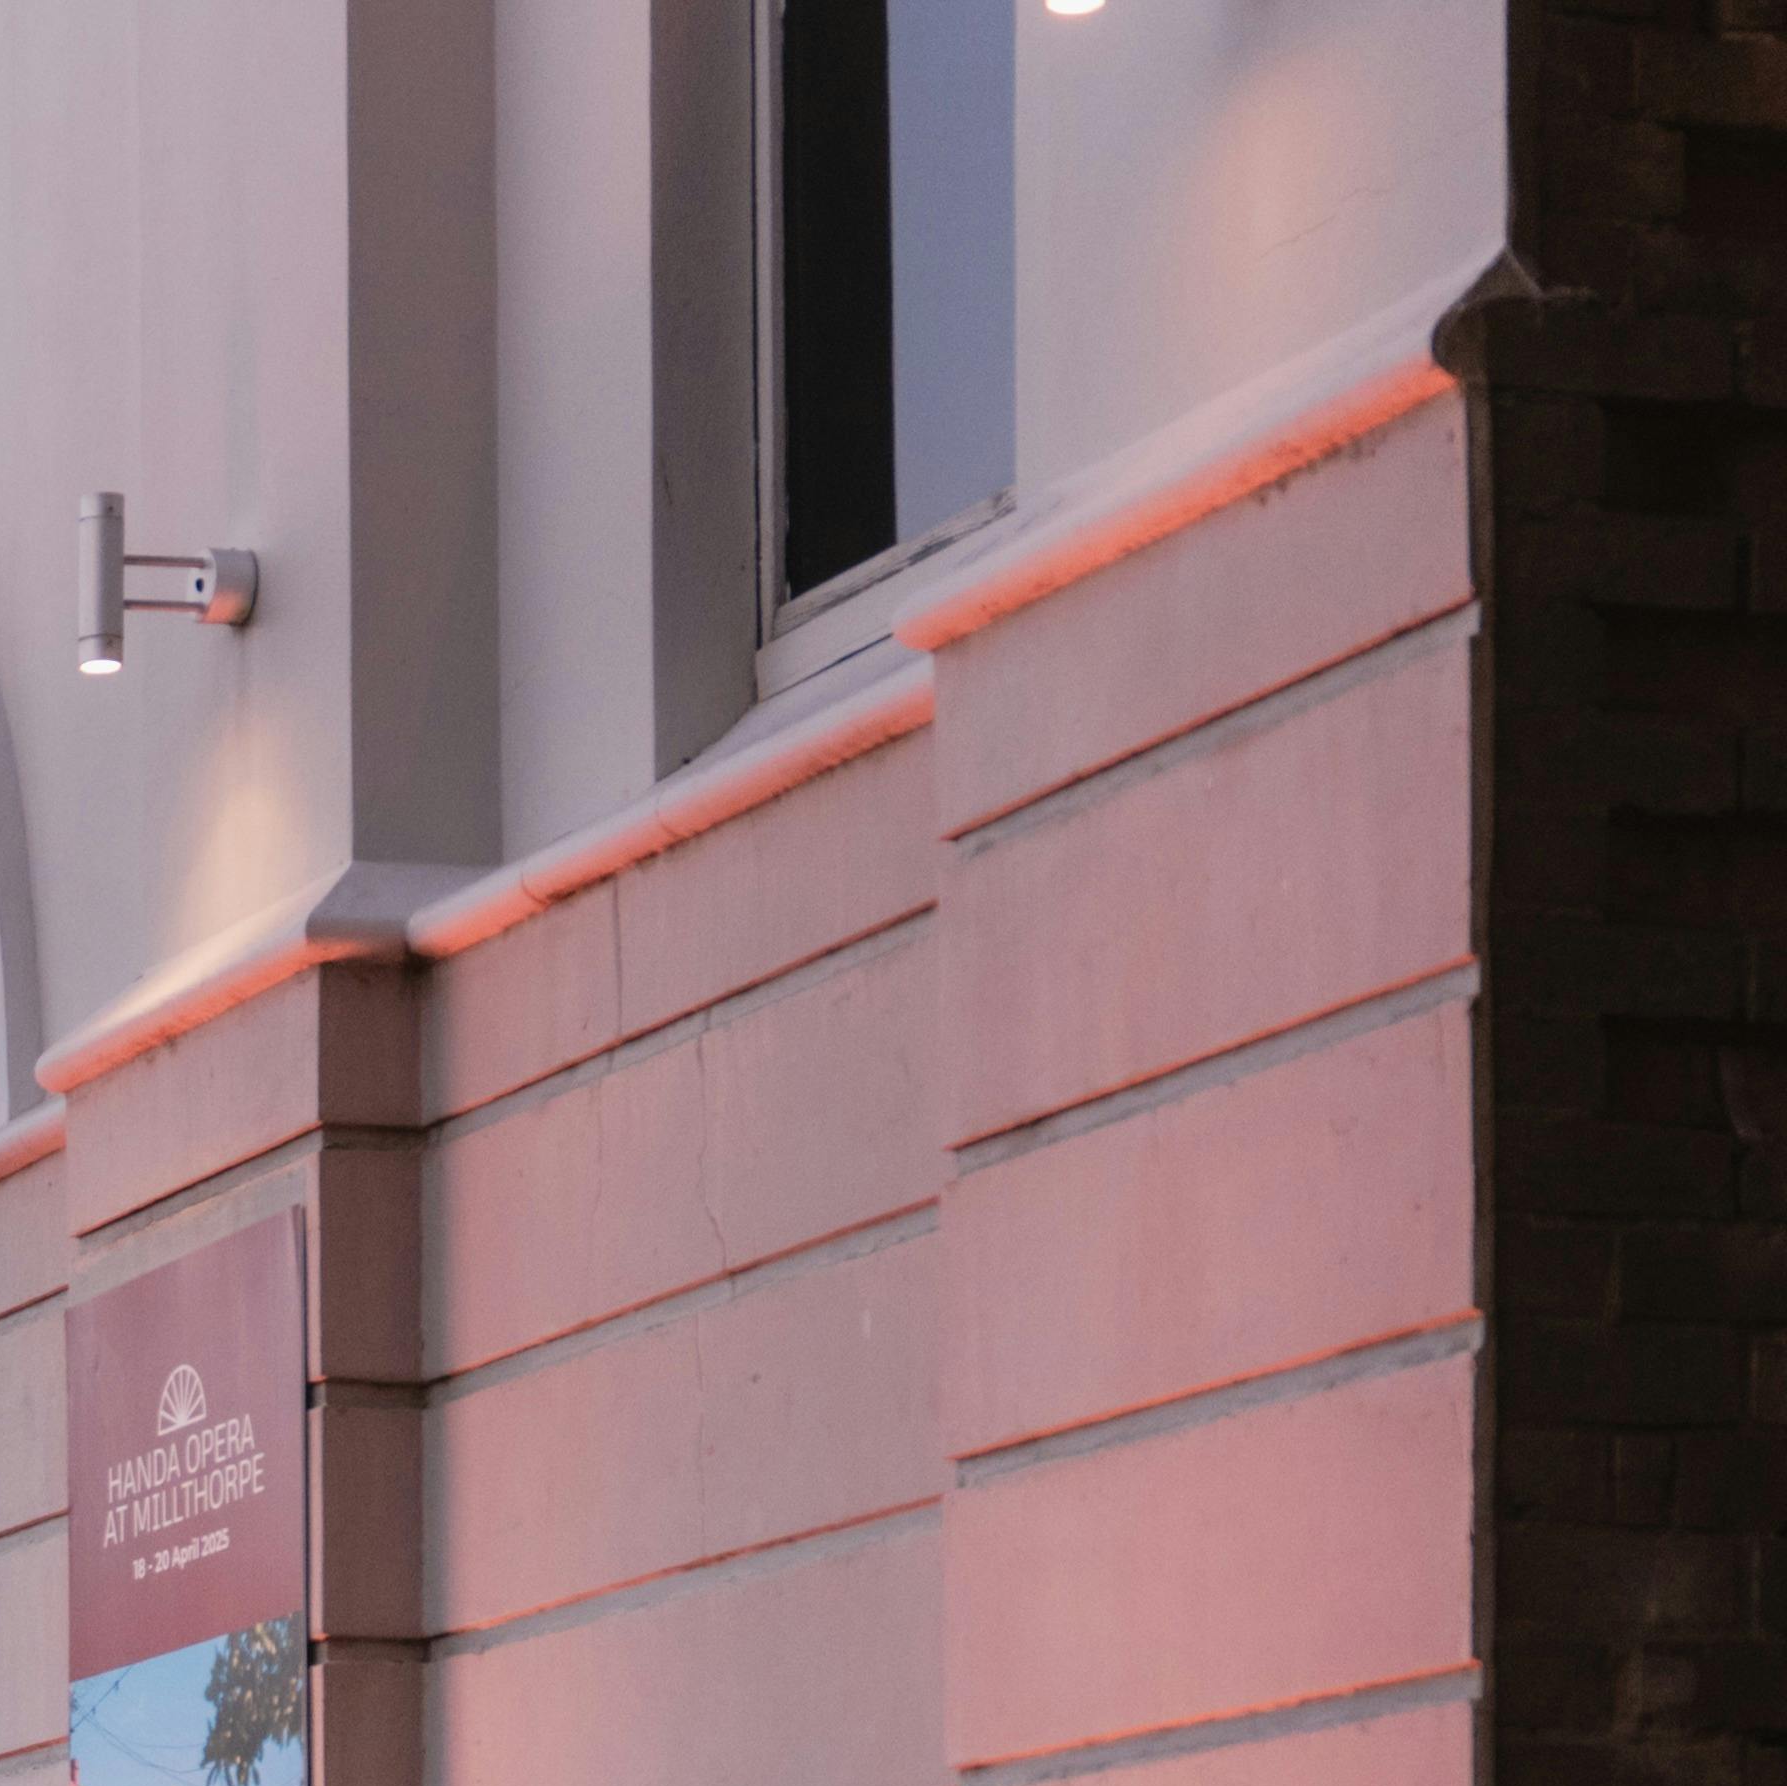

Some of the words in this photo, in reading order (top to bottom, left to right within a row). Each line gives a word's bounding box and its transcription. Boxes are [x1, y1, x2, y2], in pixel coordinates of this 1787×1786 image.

[103, 1504, 129, 1549] AT
[133, 1452, 266, 1538] MILLTHORPE
[108, 1442, 182, 1504] HANDA
[185, 1413, 256, 1474] OPERA
[132, 1557, 146, 1581] 18
[154, 1549, 171, 1575] 20
[171, 1536, 201, 1572] April
[201, 1526, 230, 1558] 2025
